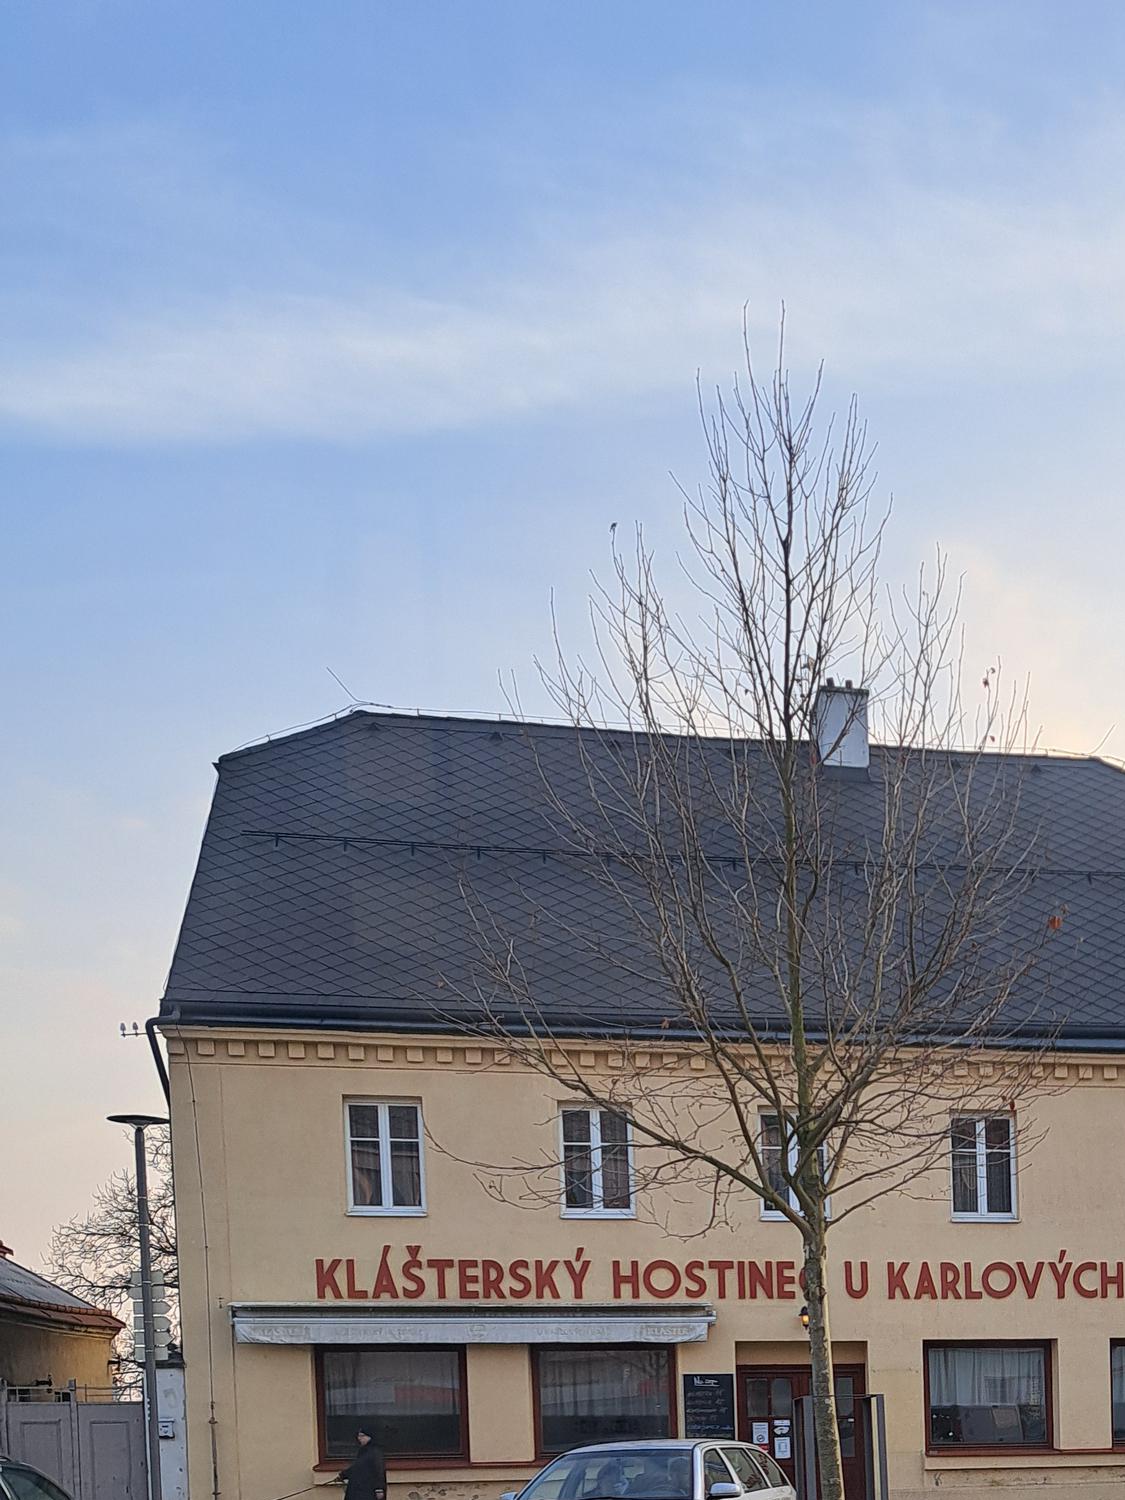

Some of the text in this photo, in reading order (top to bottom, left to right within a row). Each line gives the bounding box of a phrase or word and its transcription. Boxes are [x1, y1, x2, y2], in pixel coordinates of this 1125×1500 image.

[314, 1244, 592, 1299] KLÁŠTERSKÝ
[612, 1259, 807, 1299] HOSTINE
[844, 1260, 869, 1299] U
[887, 1249, 1124, 1299] KARLOVÝCH
